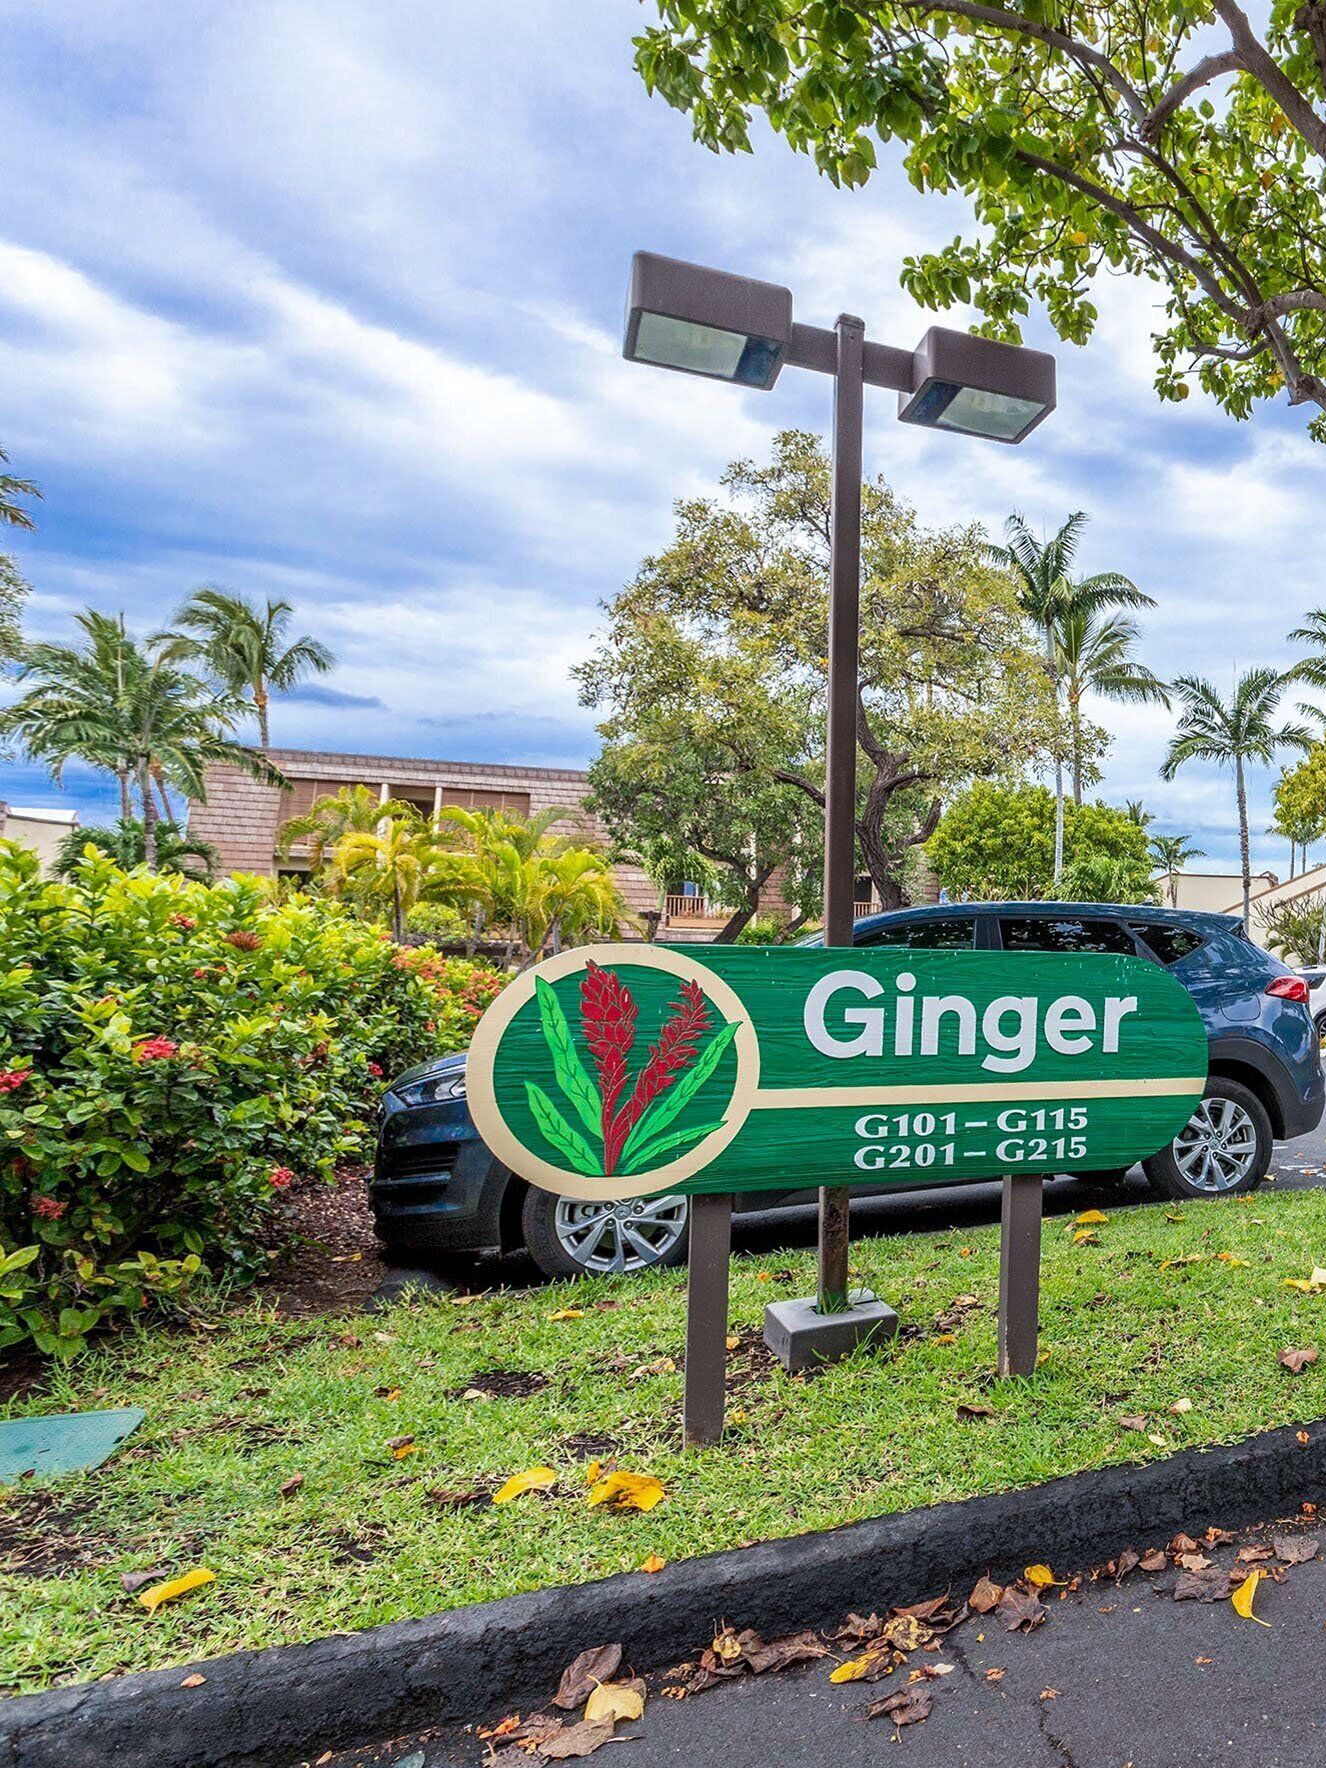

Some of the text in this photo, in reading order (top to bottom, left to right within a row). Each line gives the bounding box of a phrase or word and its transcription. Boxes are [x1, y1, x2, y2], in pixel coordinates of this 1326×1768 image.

[803, 969, 1138, 1074] Ginger
[854, 1112, 956, 1139] G101
[996, 1107, 1088, 1133] G115
[853, 1143, 955, 1170] G201
[995, 1136, 1087, 1162] G215
